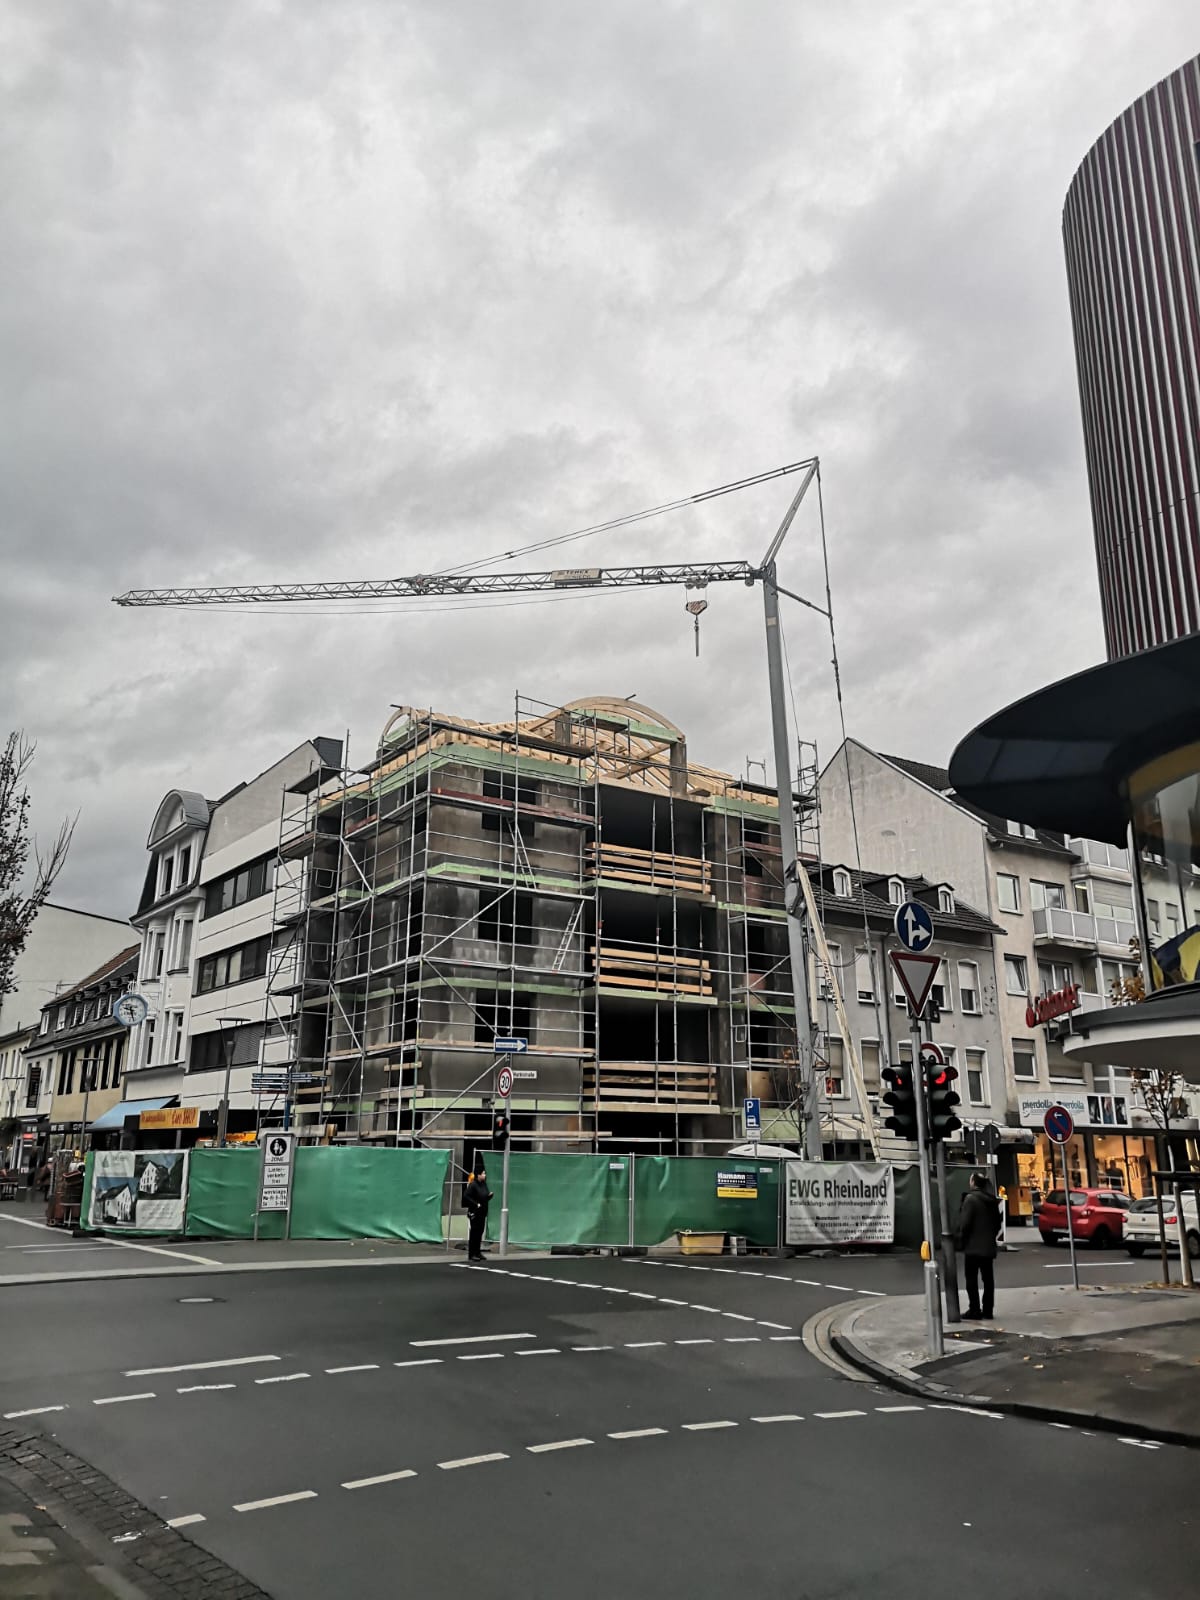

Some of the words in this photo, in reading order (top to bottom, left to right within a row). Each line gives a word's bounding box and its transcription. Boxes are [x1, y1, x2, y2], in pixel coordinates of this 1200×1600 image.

[500, 1076, 510, 1088] 30
[746, 1101, 754, 1113] P
[789, 1179, 820, 1198] EWG
[823, 1179, 888, 1198] Rheinland
